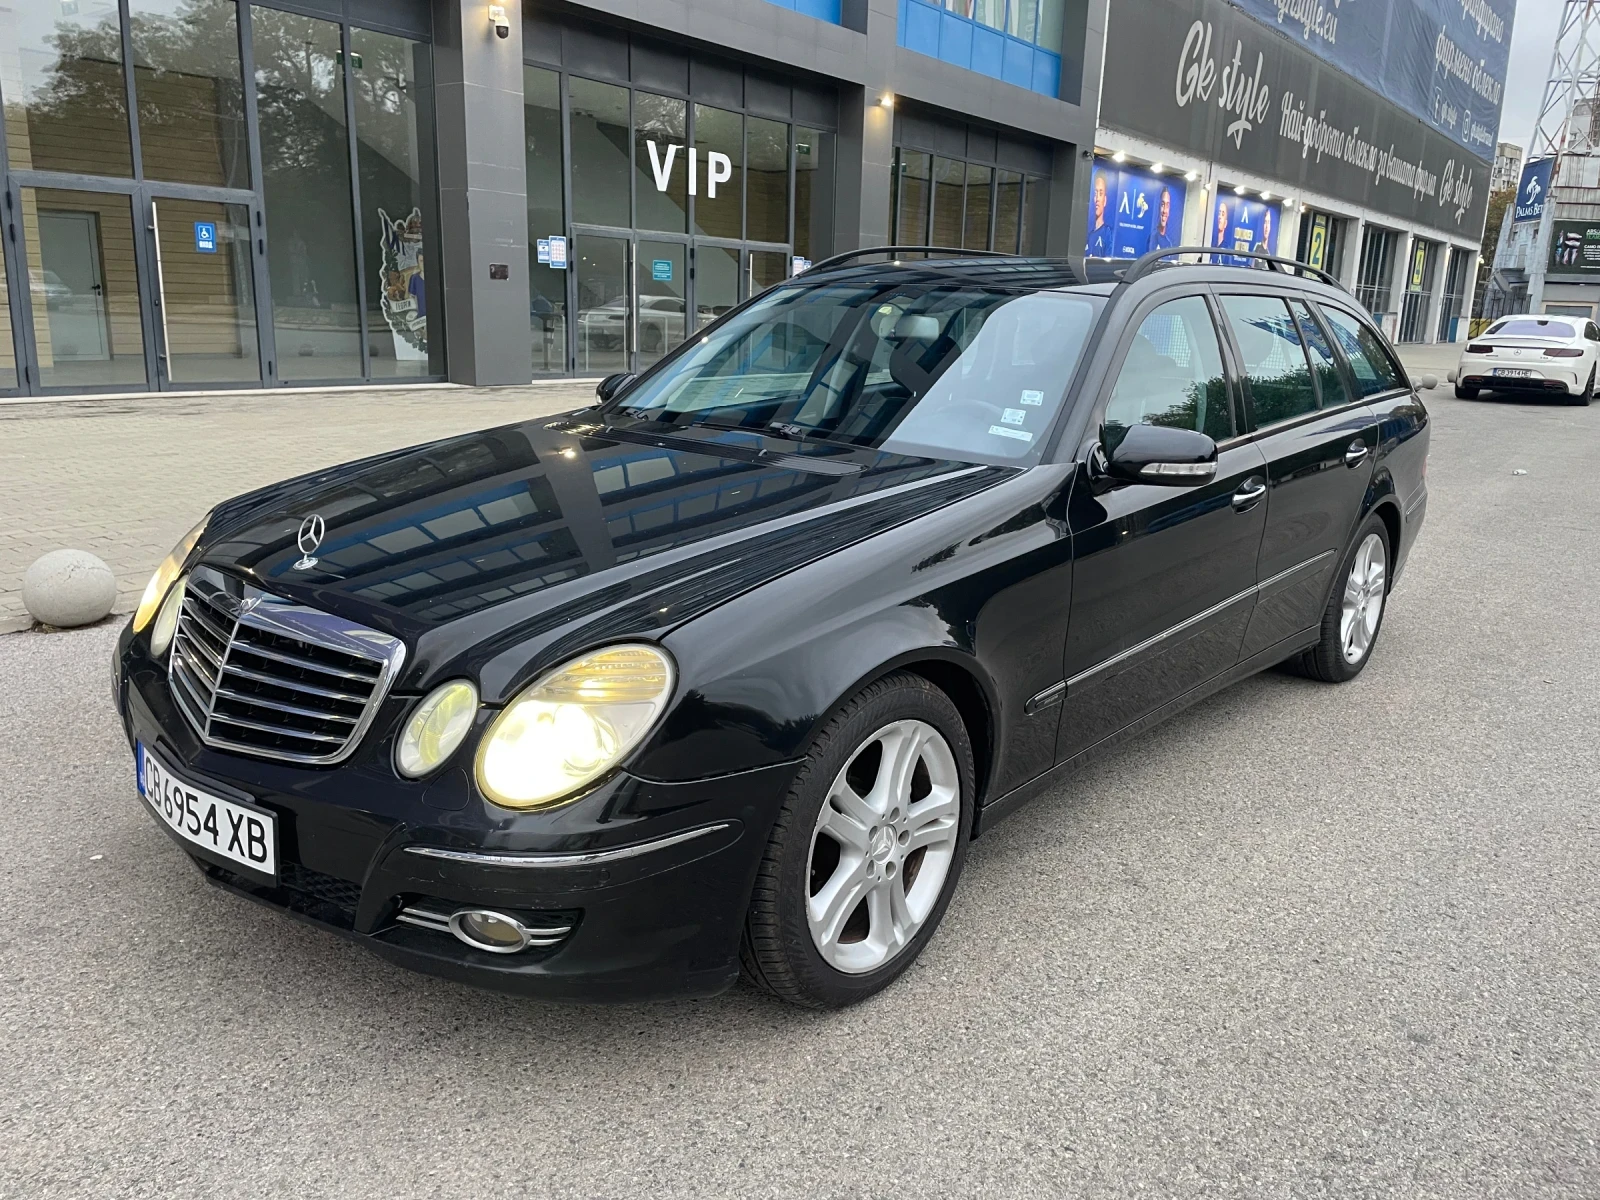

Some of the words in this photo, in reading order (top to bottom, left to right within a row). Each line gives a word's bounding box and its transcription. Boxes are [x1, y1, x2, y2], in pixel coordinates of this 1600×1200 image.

[1176, 20, 1217, 107] Gk
[1218, 39, 1270, 150] style
[1435, 24, 1473, 85] фирмено
[646, 139, 732, 199] VIP
[1280, 91, 1345, 163] Най-доброто
[1344, 126, 1378, 172] облекло
[1375, 150, 1388, 186] за
[1414, 160, 1437, 202] фирма
[1439, 159, 1455, 207] Gk
[1453, 164, 1474, 225] style
[1515, 204, 1533, 218] PALMS
[1312, 232, 1322, 265] 2
[1415, 253, 1422, 280] 4
[164, 778, 219, 846] 6954
[226, 808, 267, 863] XB
